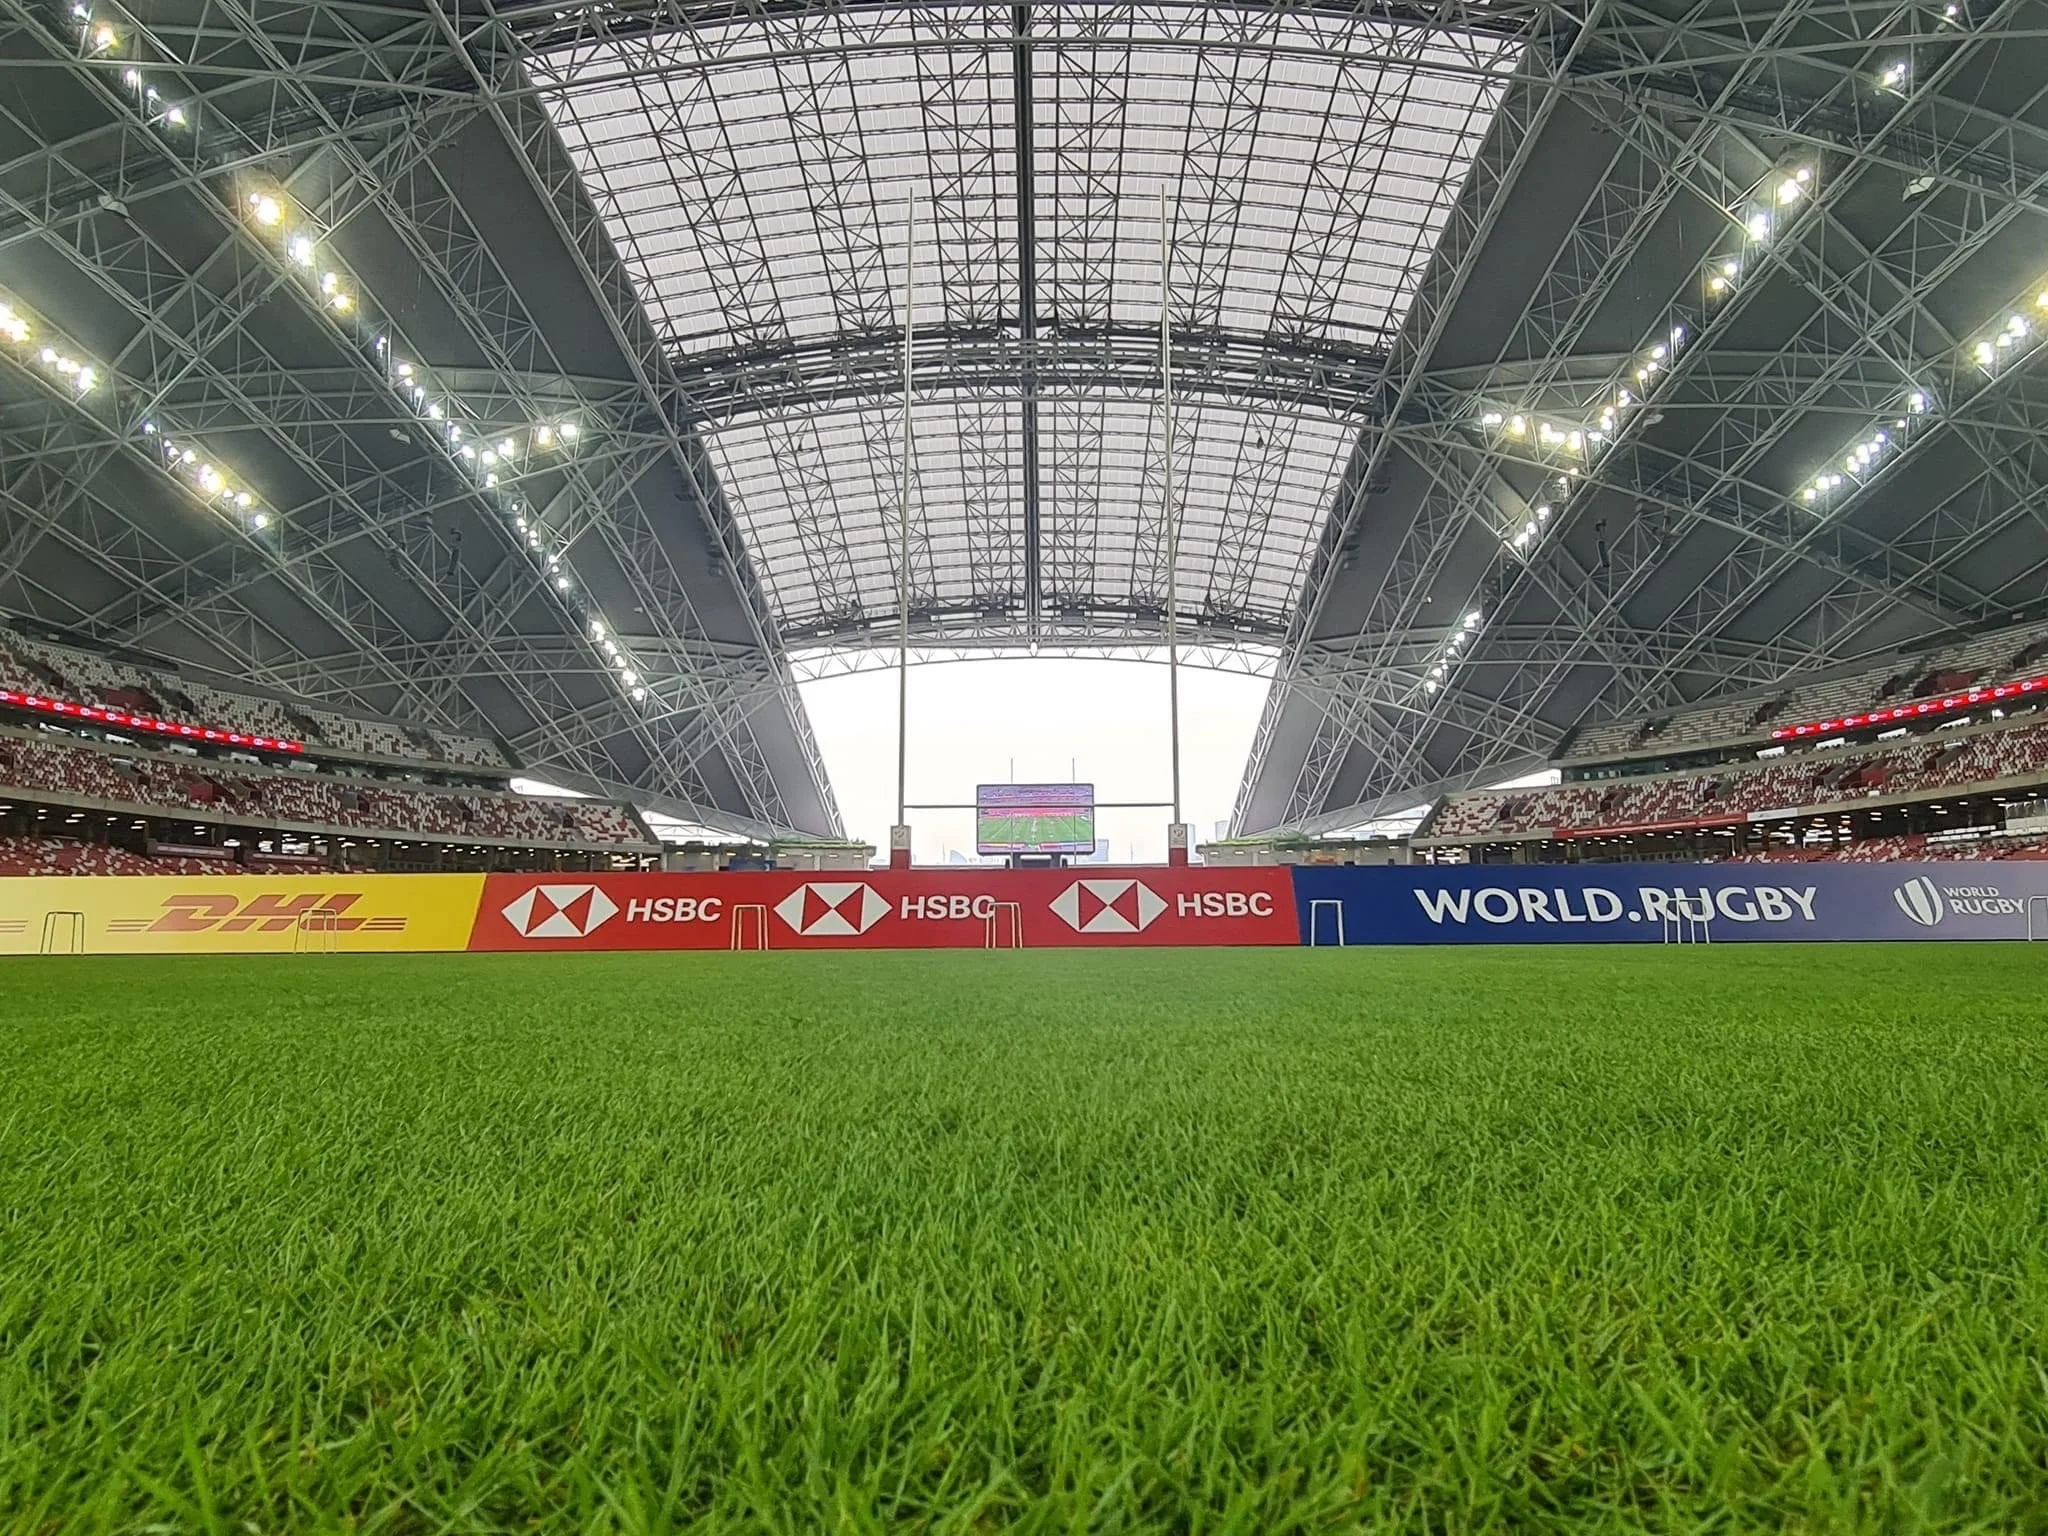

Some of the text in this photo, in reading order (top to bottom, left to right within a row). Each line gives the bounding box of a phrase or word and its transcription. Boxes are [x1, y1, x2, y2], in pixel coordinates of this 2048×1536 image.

[1177, 892, 1273, 917] HSBC
[1943, 887, 2000, 897] WORLD
[145, 894, 365, 932] DHL
[626, 898, 722, 923] HSBC
[901, 895, 996, 919] HSBC
[1413, 887, 1816, 924] WORLD.RUGBY
[1949, 898, 2025, 914] RUGBY
